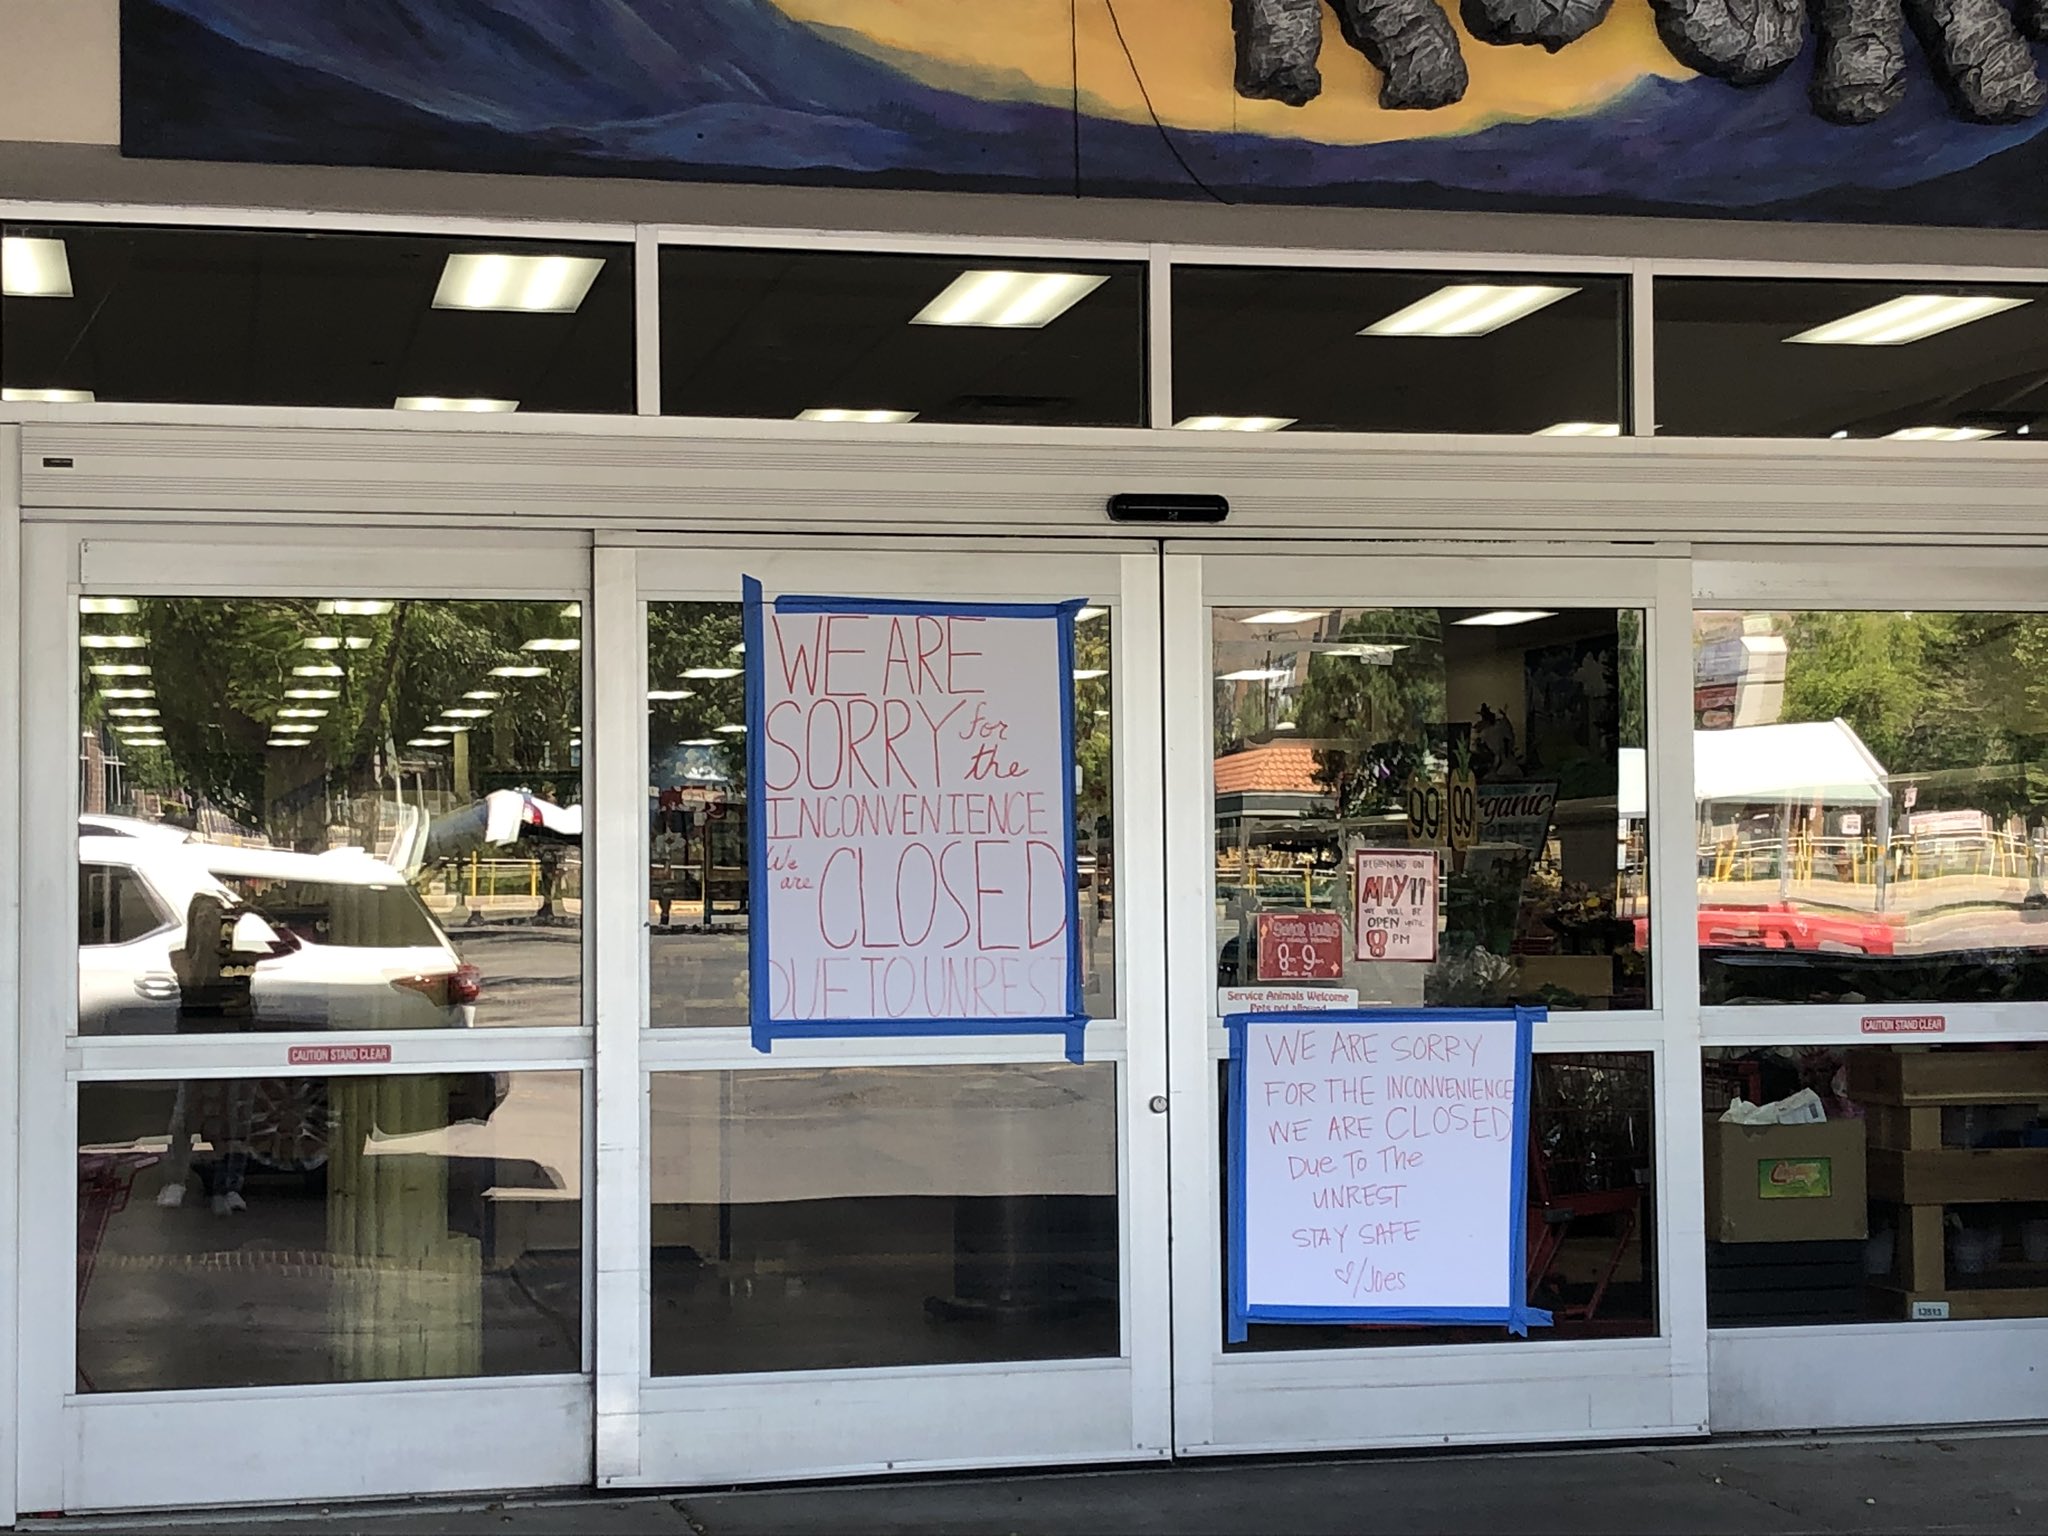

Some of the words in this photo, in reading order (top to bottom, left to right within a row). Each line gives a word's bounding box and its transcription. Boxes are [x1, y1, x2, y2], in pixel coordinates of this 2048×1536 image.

[772, 615, 869, 696] WE
[883, 616, 986, 695] ARE
[765, 699, 966, 790] SORRY
[959, 701, 1008, 741] for
[964, 744, 1029, 781] the
[765, 791, 1048, 839] INCONVENIENCE
[1477, 787, 1551, 825] rganic
[780, 876, 814, 890] are
[818, 840, 1067, 950] CLOSED
[1362, 875, 1409, 906] MAY
[1367, 917, 1400, 929] OPEN
[1392, 933, 1410, 944] PM
[860, 957, 916, 1018] TO
[923, 956, 1066, 1018] UNREST
[1227, 990, 1263, 1001] Service
[1266, 990, 1303, 1001] Animals
[1307, 991, 1349, 1002] Welcome
[1864, 1019, 1894, 1031] CAUTION
[1895, 1019, 1918, 1031] STAND
[1919, 1018, 1942, 1030] CLEAR
[292, 1049, 329, 1062] CAUTION
[330, 1048, 358, 1061] STAND
[360, 1047, 388, 1060] CLEAR
[1265, 1029, 1316, 1066] WE
[1330, 1031, 1378, 1064] ARE
[1391, 1033, 1483, 1067] SORRY
[1264, 1080, 1317, 1106] FOR
[1324, 1075, 1376, 1106] THE
[1387, 1075, 1514, 1101] INCONVENIENCE
[1268, 1118, 1313, 1145] WE
[1328, 1116, 1374, 1141] ARE
[1385, 1103, 1512, 1142] CLOSED
[1288, 1155, 1338, 1180] Due
[1344, 1150, 1367, 1179] To
[1377, 1146, 1424, 1173] The
[1313, 1184, 1407, 1209] UNREST
[1292, 1223, 1348, 1252] STAY
[1359, 1220, 1420, 1245] SAFE
